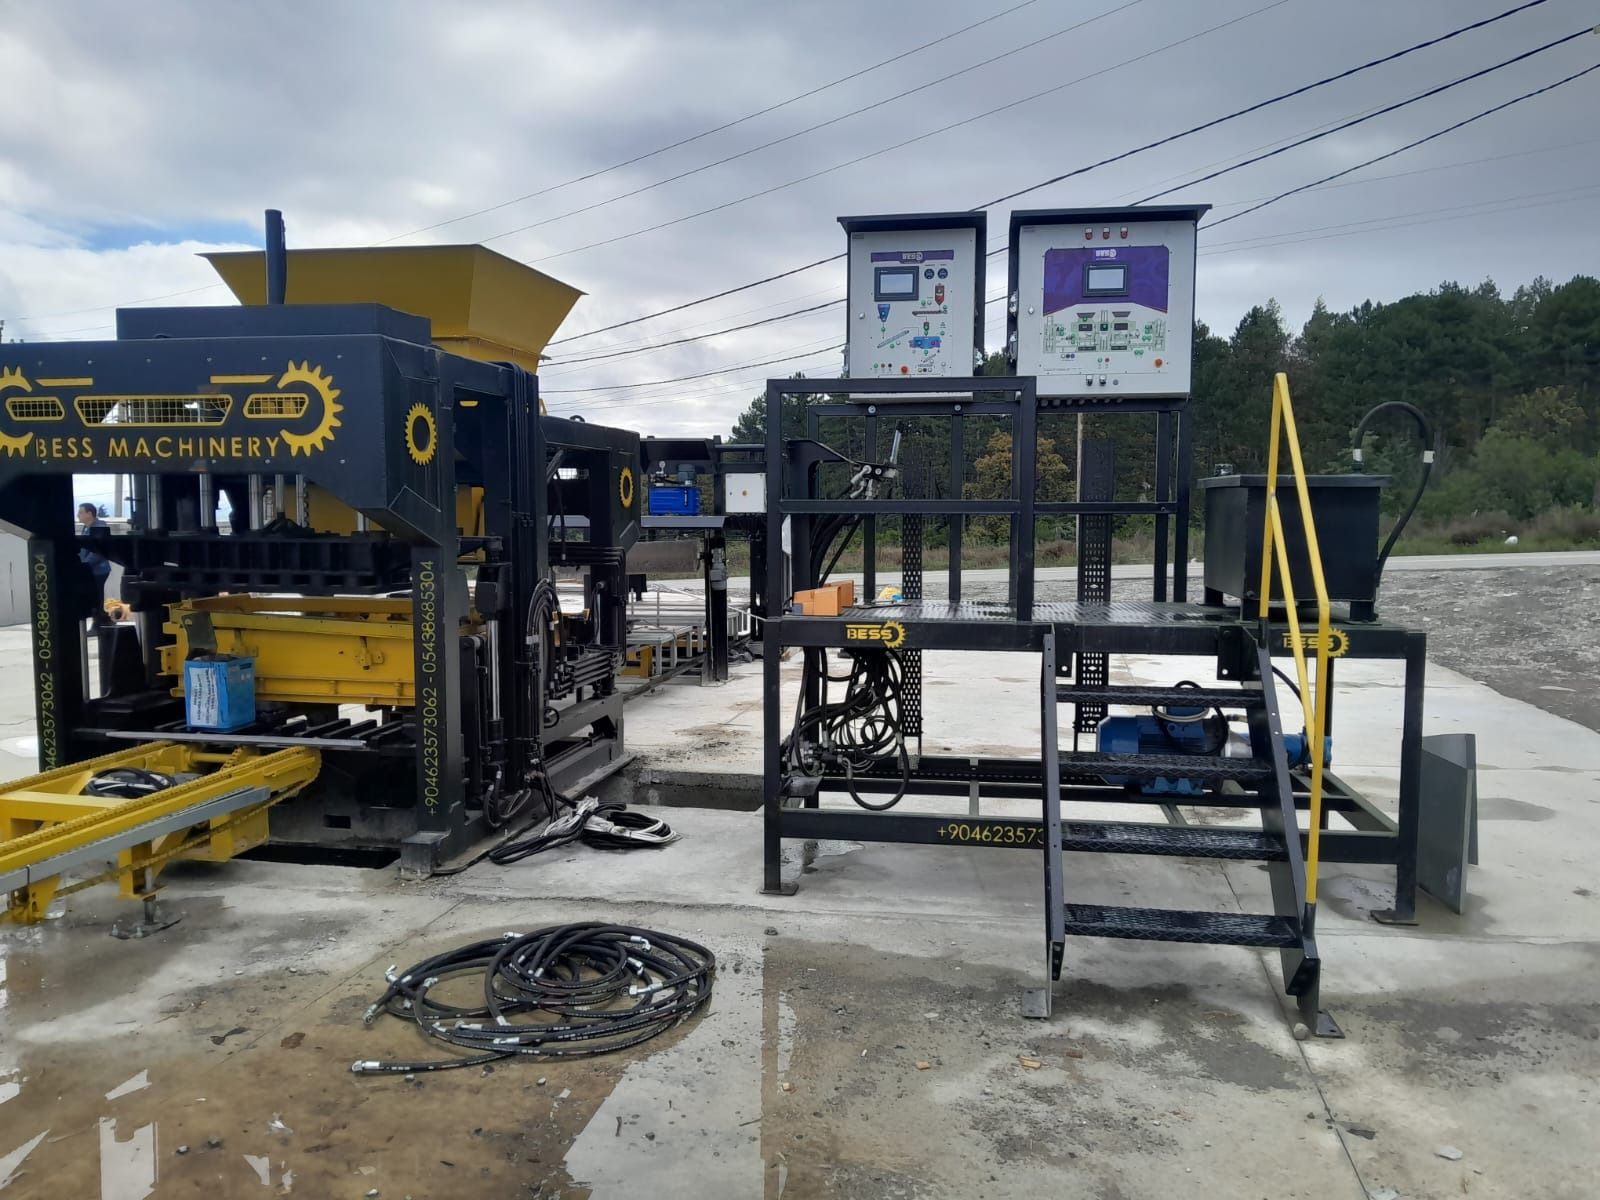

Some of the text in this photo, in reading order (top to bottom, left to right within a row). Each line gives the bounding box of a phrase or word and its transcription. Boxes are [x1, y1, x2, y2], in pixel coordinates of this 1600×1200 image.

[35, 435, 281, 459] BESS MACHINERY
[420, 560, 437, 673] 05438685304
[846, 628, 893, 640] BESS
[423, 687, 440, 816] +904623573062
